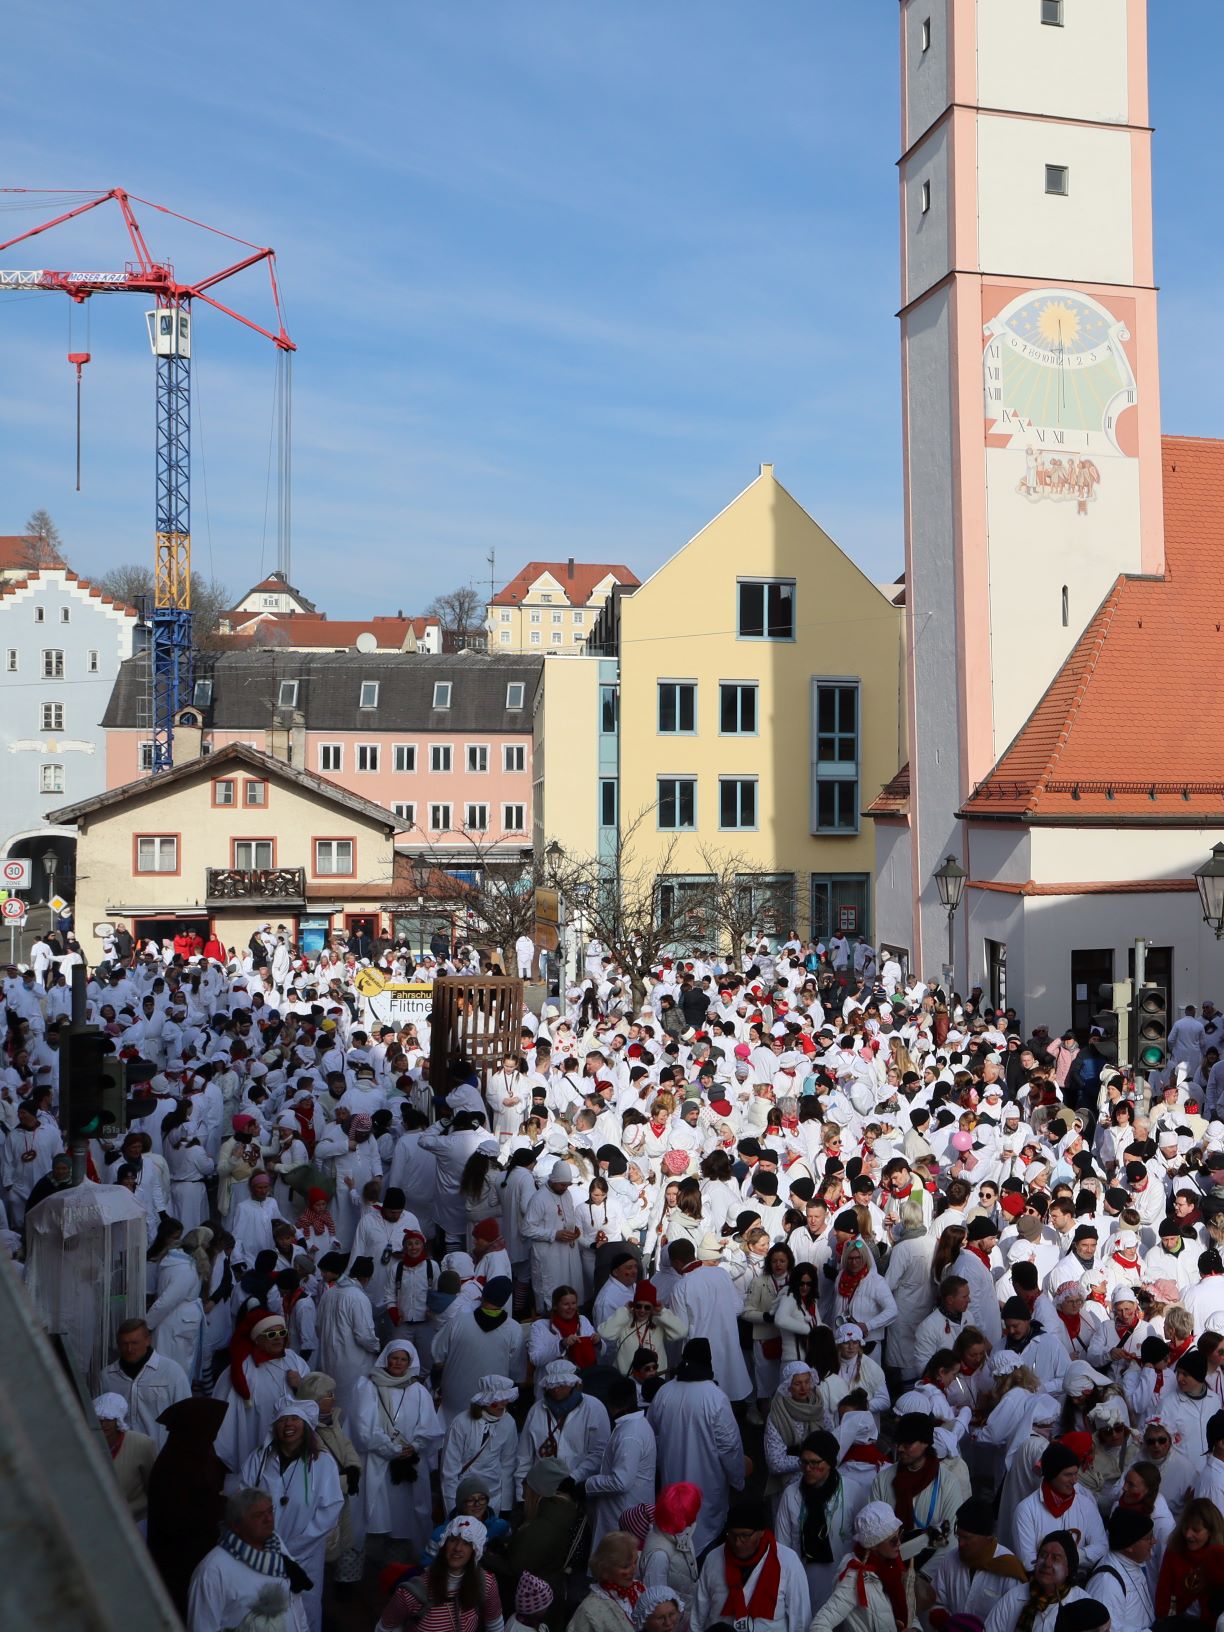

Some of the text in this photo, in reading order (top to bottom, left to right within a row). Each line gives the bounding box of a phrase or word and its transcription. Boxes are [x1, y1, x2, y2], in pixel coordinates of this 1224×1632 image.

[69, 273, 127, 282] MOSER-KRAN
[989, 344, 1000, 359] VI
[987, 366, 1000, 381] VII
[8, 867, 20, 876] 30
